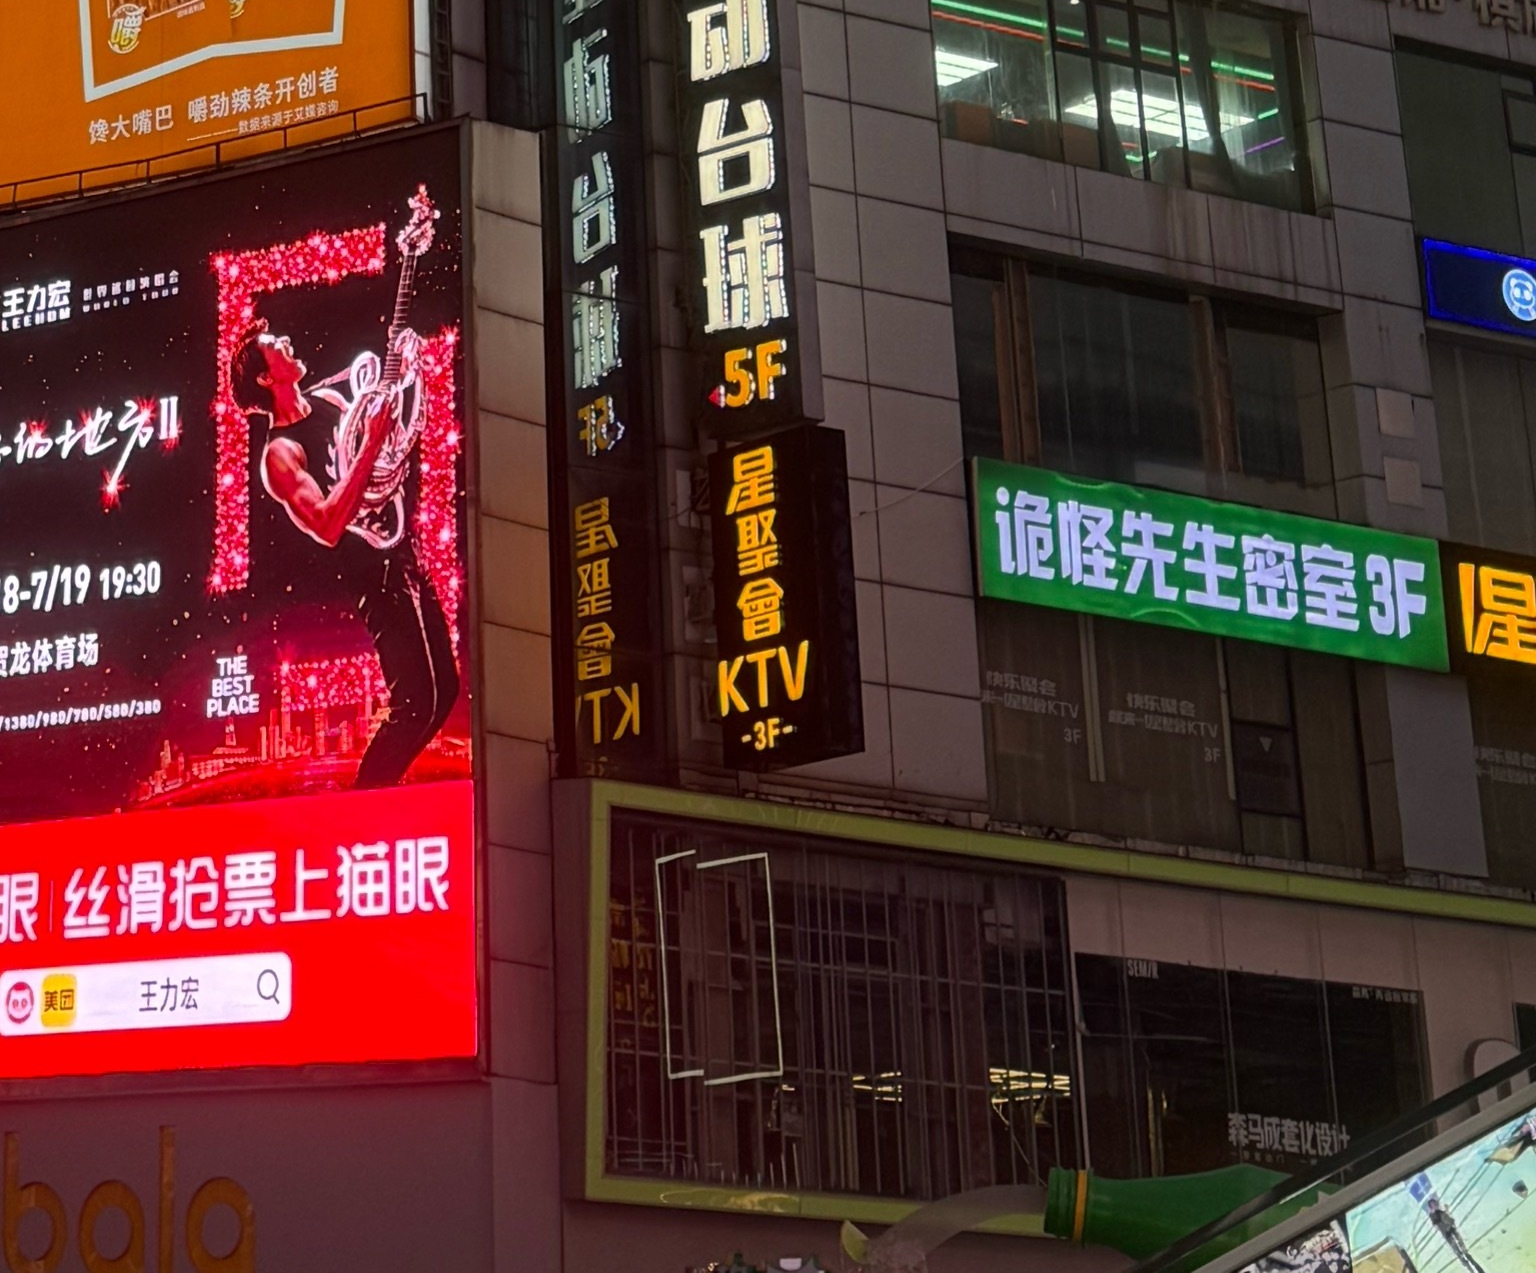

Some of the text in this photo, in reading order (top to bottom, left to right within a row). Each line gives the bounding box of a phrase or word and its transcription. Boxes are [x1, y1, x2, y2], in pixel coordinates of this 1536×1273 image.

[87, 66, 340, 146] 馋大嘴巴 嚼劲辣条开创者
[2, 280, 72, 318] 王力宏
[724, 339, 787, 409] 5F
[725, 445, 786, 643] 星聚會
[994, 486, 1428, 640] 诡怪先生密室3F
[99, 560, 162, 600] 19:30
[216, 656, 248, 676] THE
[717, 639, 810, 718] KTV
[206, 694, 260, 718] PLACE
[212, 675, 253, 698] BEST
[1063, 727, 1083, 745] 3F
[1203, 747, 1222, 763] 3F
[63, 837, 451, 939] 丝滑抢票上猫眼
[43, 976, 201, 1014] 美团 王力宏
